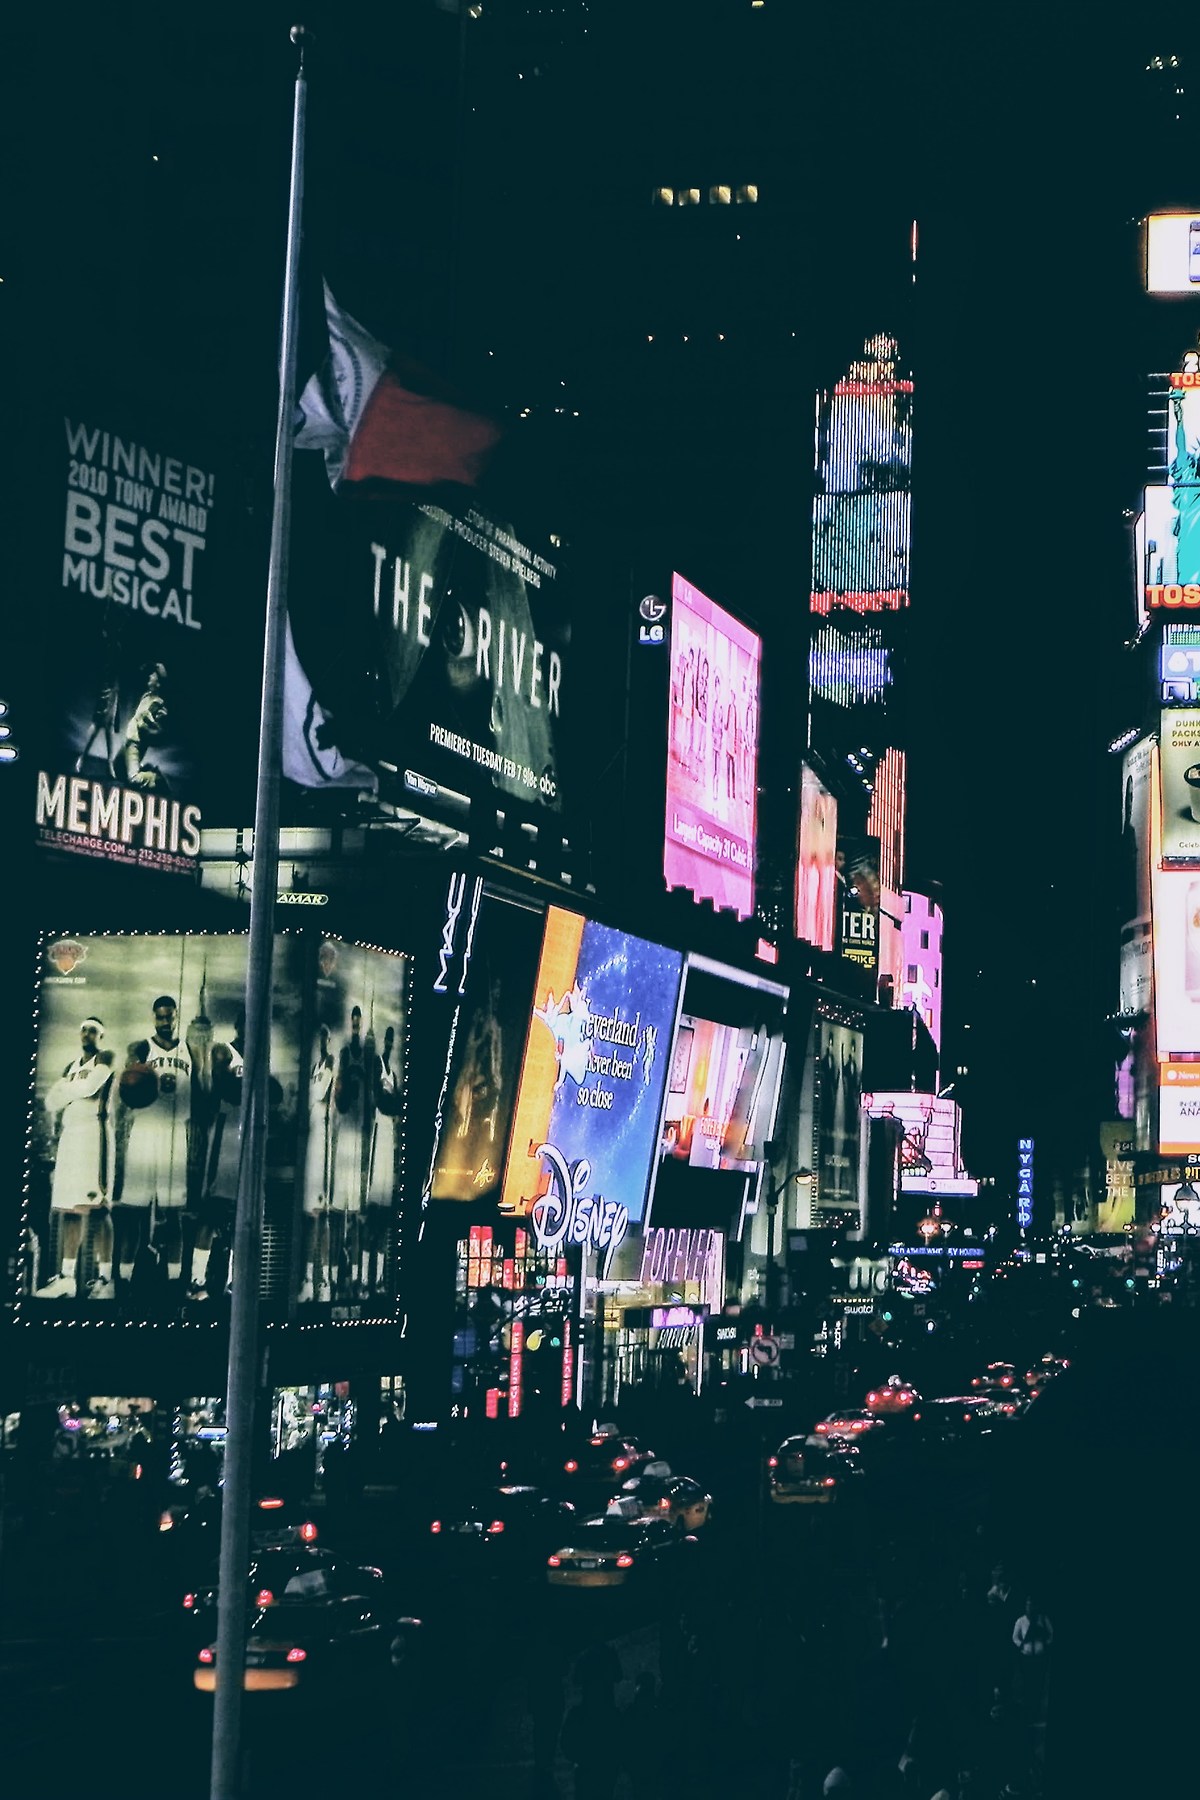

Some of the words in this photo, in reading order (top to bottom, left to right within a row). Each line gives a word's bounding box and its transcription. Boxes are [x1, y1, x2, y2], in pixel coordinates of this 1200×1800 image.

[64, 416, 215, 508] WINNER!
[68, 459, 107, 496] 2010
[115, 475, 153, 513] TONY
[159, 493, 207, 533] AWARD
[64, 489, 206, 591] BEST
[62, 553, 201, 630] MUSICAL
[371, 541, 433, 648] THE
[476, 607, 561, 717] RIVER
[640, 625, 664, 643] LG
[430, 723, 471, 758] PREMIERES
[472, 743, 503, 772] TUESDAY
[503, 758, 516, 779] FEB
[517, 765, 523, 780] 7
[540, 774, 556, 797] abc
[36, 770, 202, 856] MEMPHIS
[39, 828, 126, 856] TELECHARGE.COM
[278, 892, 322, 905] AMAR
[578, 1087, 589, 1105] so
[590, 1081, 614, 1110] close
[611, 1050, 632, 1080] been
[640, 1227, 716, 1282] FOREVER
